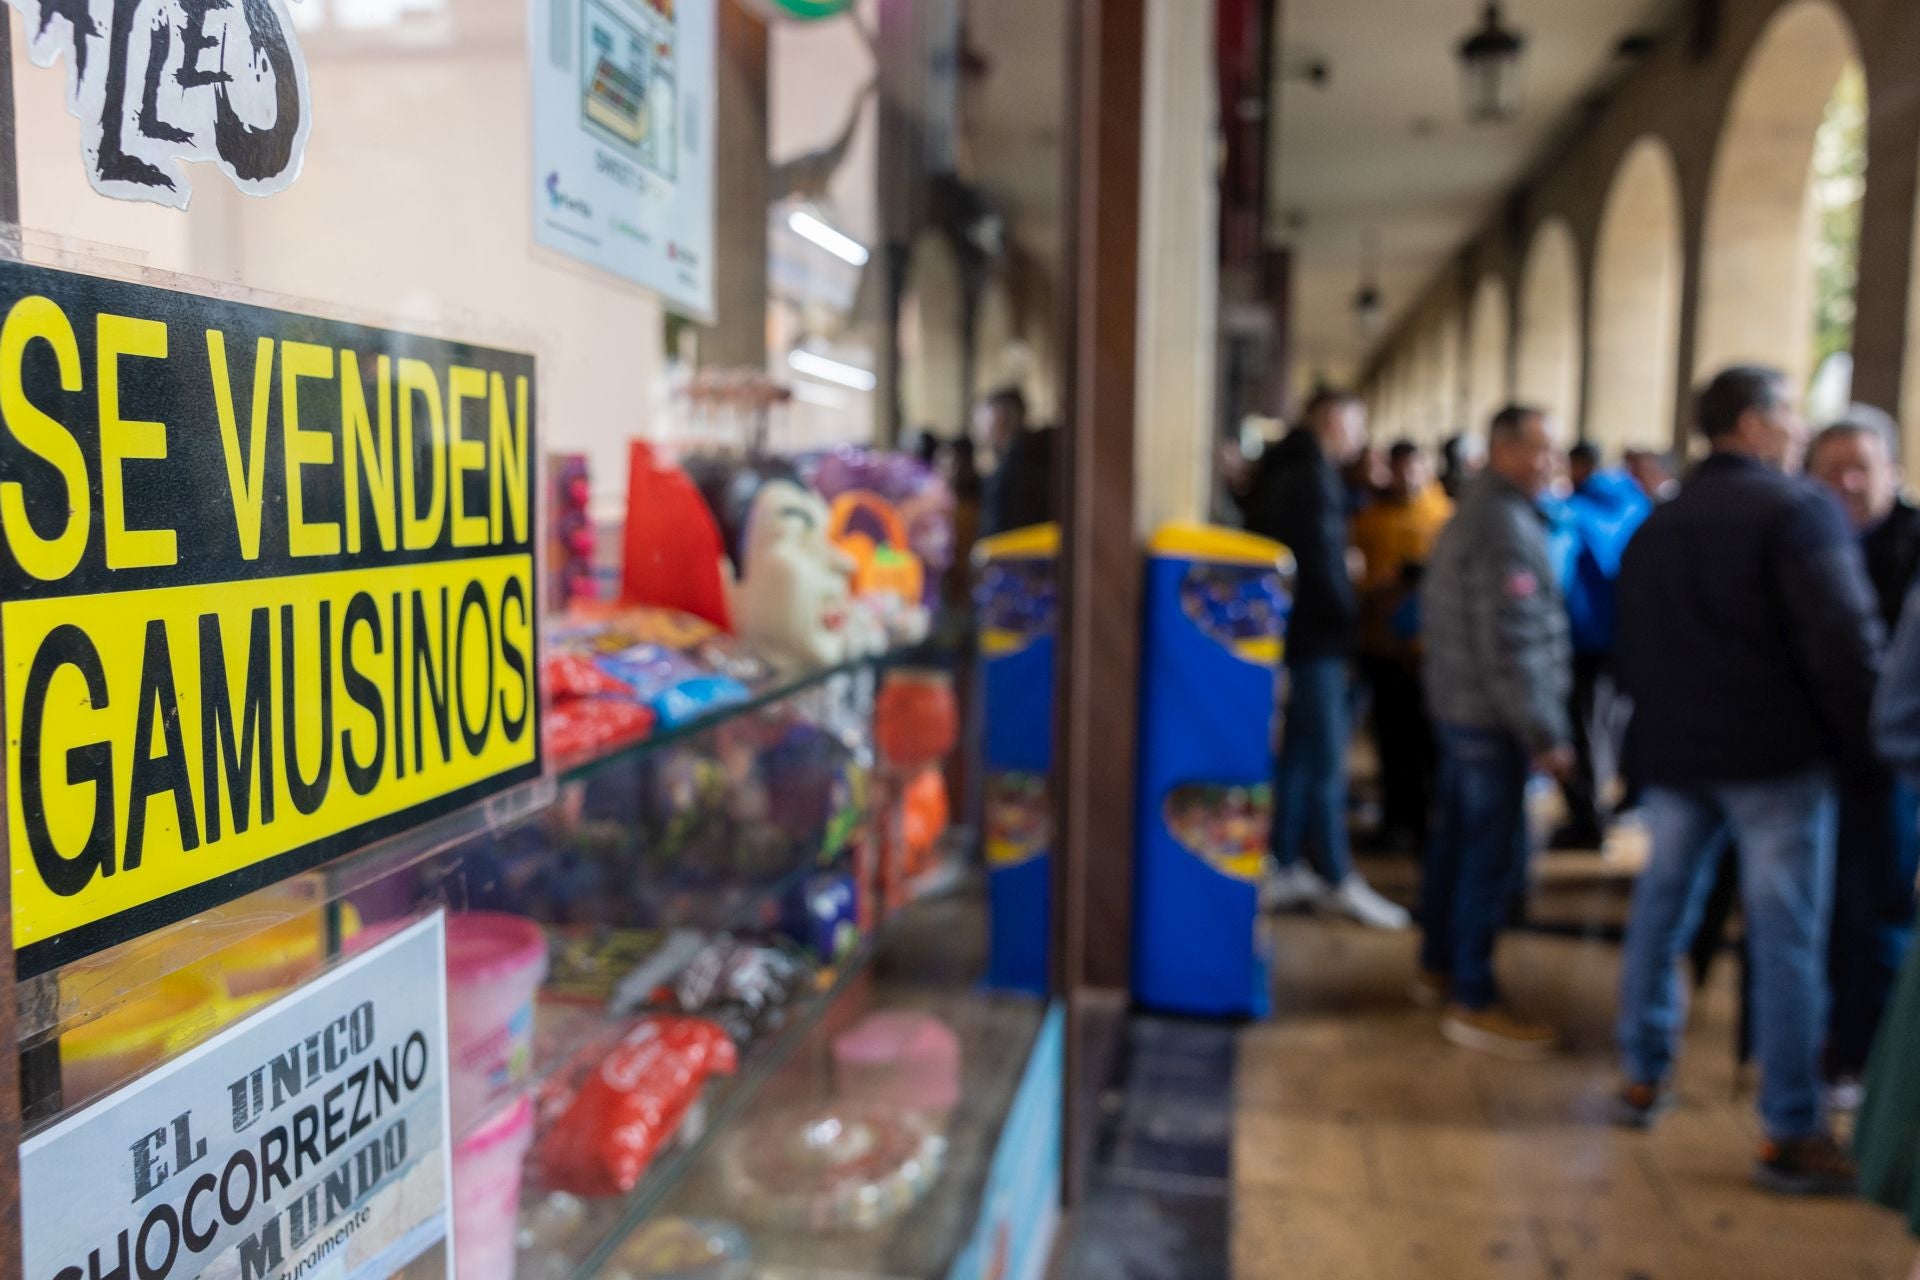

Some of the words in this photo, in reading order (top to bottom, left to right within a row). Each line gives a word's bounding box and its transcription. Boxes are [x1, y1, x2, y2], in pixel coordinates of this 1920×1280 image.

[0, 295, 178, 581] SE
[206, 329, 528, 560] VENDEN
[19, 575, 528, 897] GAMUSINOS
[52, 1029, 427, 1280] HOCORREZNO
[129, 1109, 207, 1204] EL
[236, 1121, 407, 1280] MUNDO
